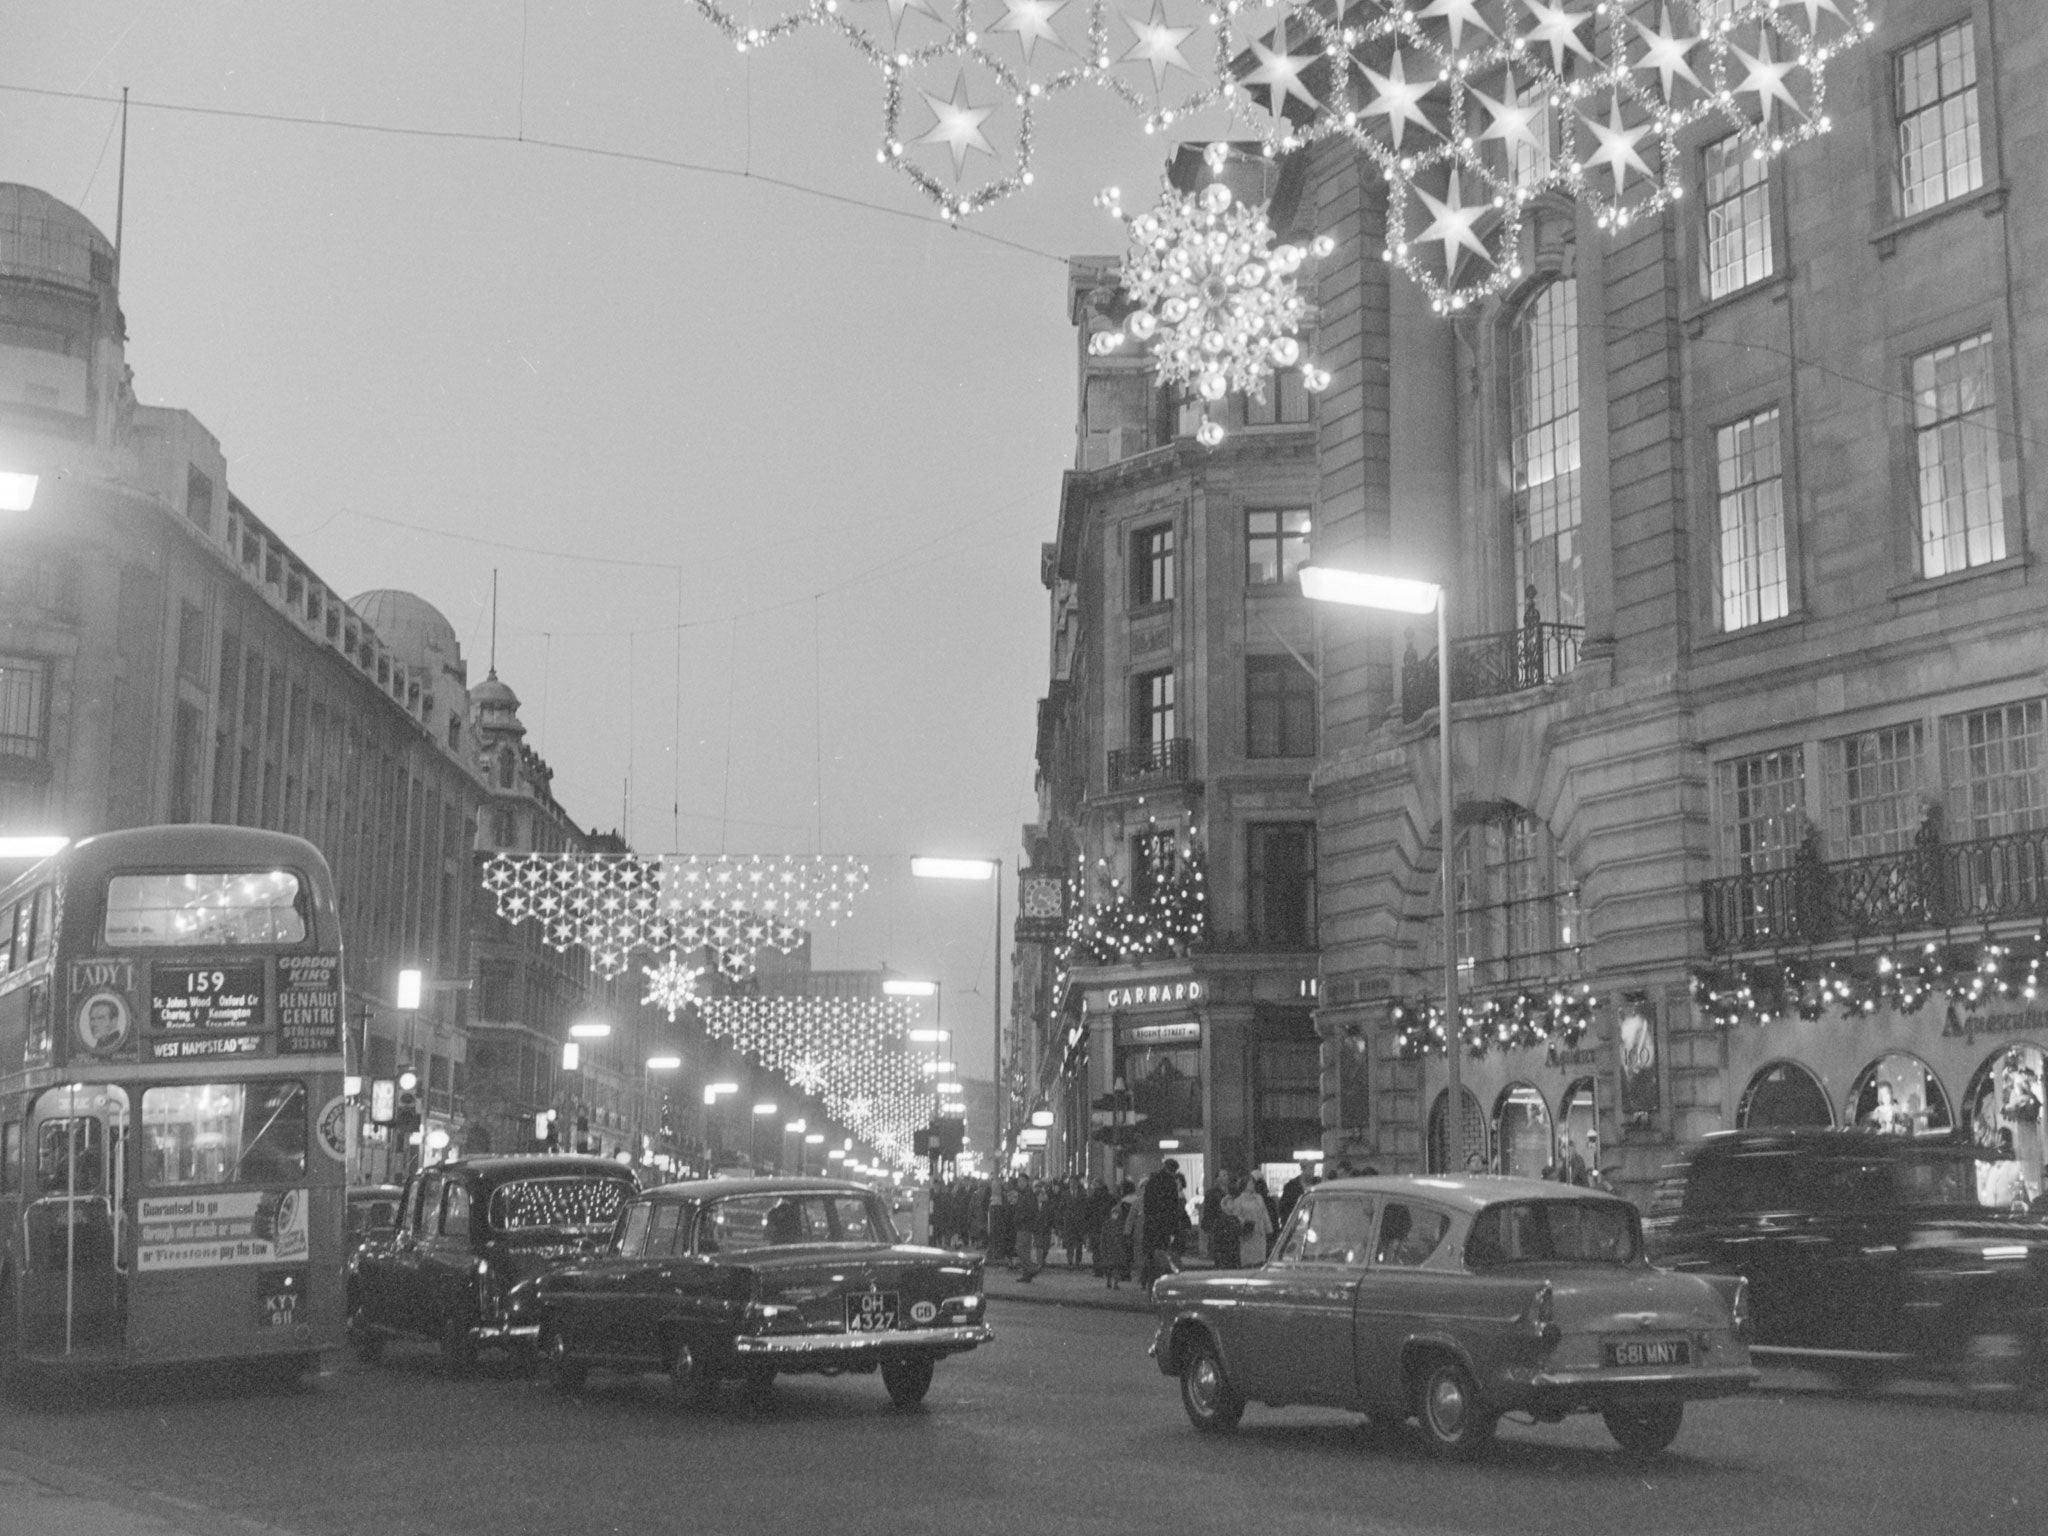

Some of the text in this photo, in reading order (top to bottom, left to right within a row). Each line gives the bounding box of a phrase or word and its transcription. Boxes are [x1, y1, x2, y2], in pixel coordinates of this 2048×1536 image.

[279, 956, 336, 969] GORDON
[72, 965, 137, 993] LADY L
[187, 971, 225, 993] 159
[289, 969, 330, 981] KING
[190, 996, 211, 1007] Wood
[219, 995, 245, 1006] Oxford
[279, 992, 337, 1008] RENAULT
[1108, 982, 1200, 1007] GARRARD
[161, 1008, 251, 1021] Charing Kennington
[283, 1008, 335, 1024] CENTRE
[1163, 1028, 1186, 1037] STREET
[154, 1043, 179, 1057] WEST
[182, 1038, 237, 1055] HAMPSTEAD
[143, 1200, 218, 1217] Guaranteed to go
[219, 1225, 229, 1236] or
[143, 1251, 153, 1262] or
[156, 1246, 218, 1261] Firestone
[220, 1245, 235, 1260] pay
[237, 1243, 250, 1255] the
[252, 1242, 268, 1255] tow
[266, 1295, 298, 1310] KYY
[915, 1305, 933, 1318] GB
[851, 1312, 895, 1330] 4327
[1616, 1344, 1678, 1364] 681 MNY
